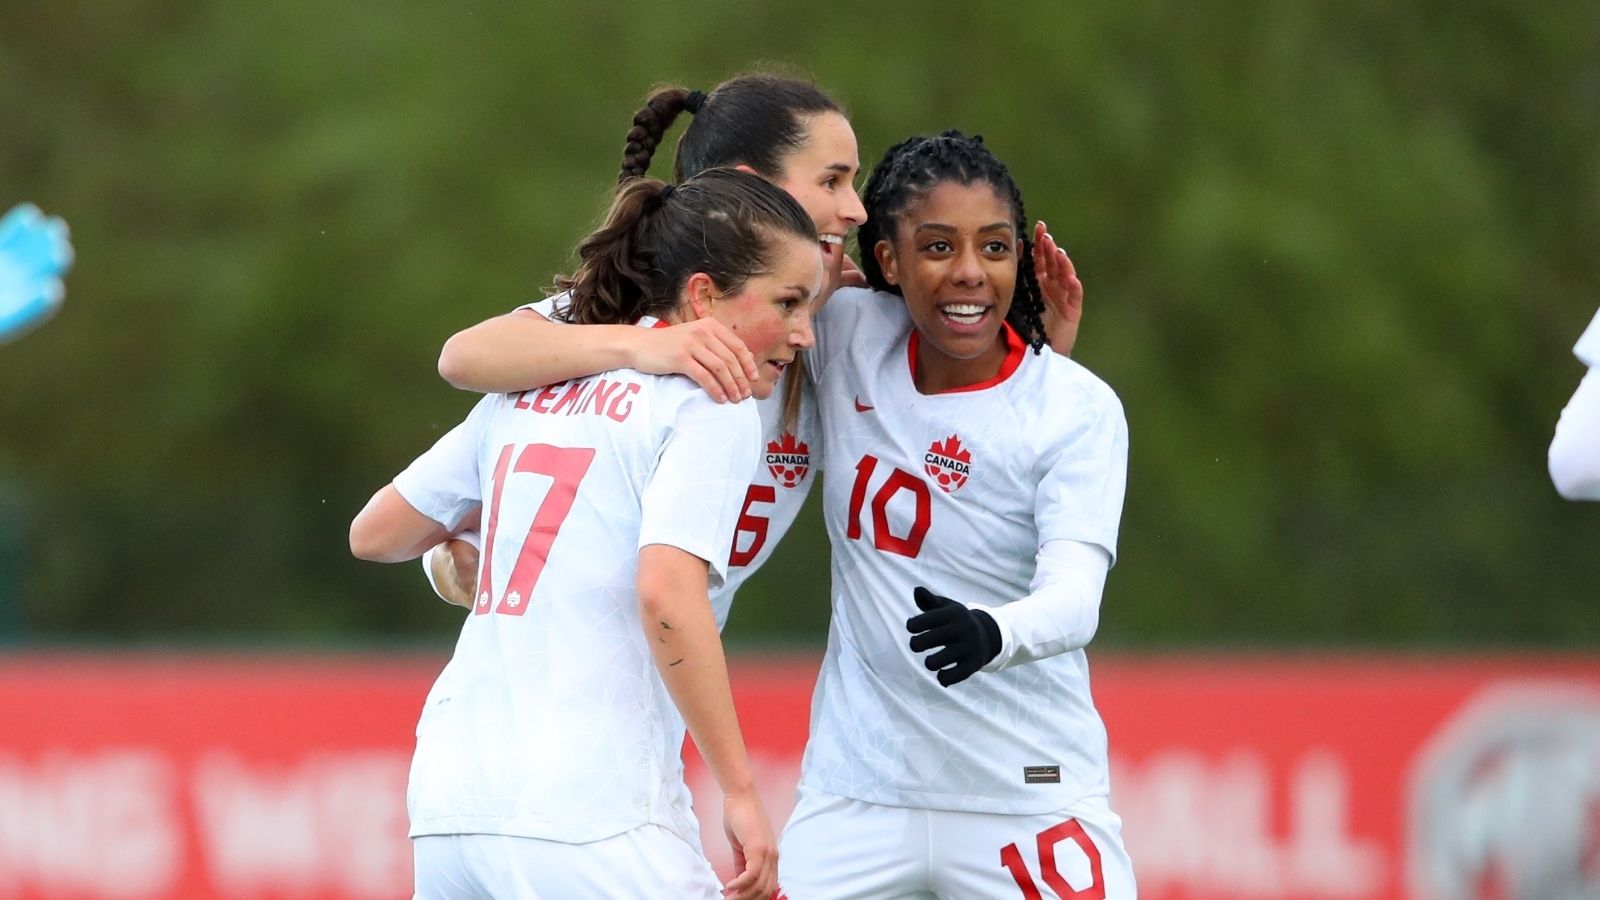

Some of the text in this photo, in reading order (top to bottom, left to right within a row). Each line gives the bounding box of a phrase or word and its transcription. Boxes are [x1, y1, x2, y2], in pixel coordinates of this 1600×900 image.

[502, 379, 642, 423] LEMING
[766, 454, 810, 466] CANADA
[924, 453, 970, 476] CANADA
[475, 443, 597, 617] 17
[847, 454, 932, 559] 10
[1000, 817, 1106, 900] 10
